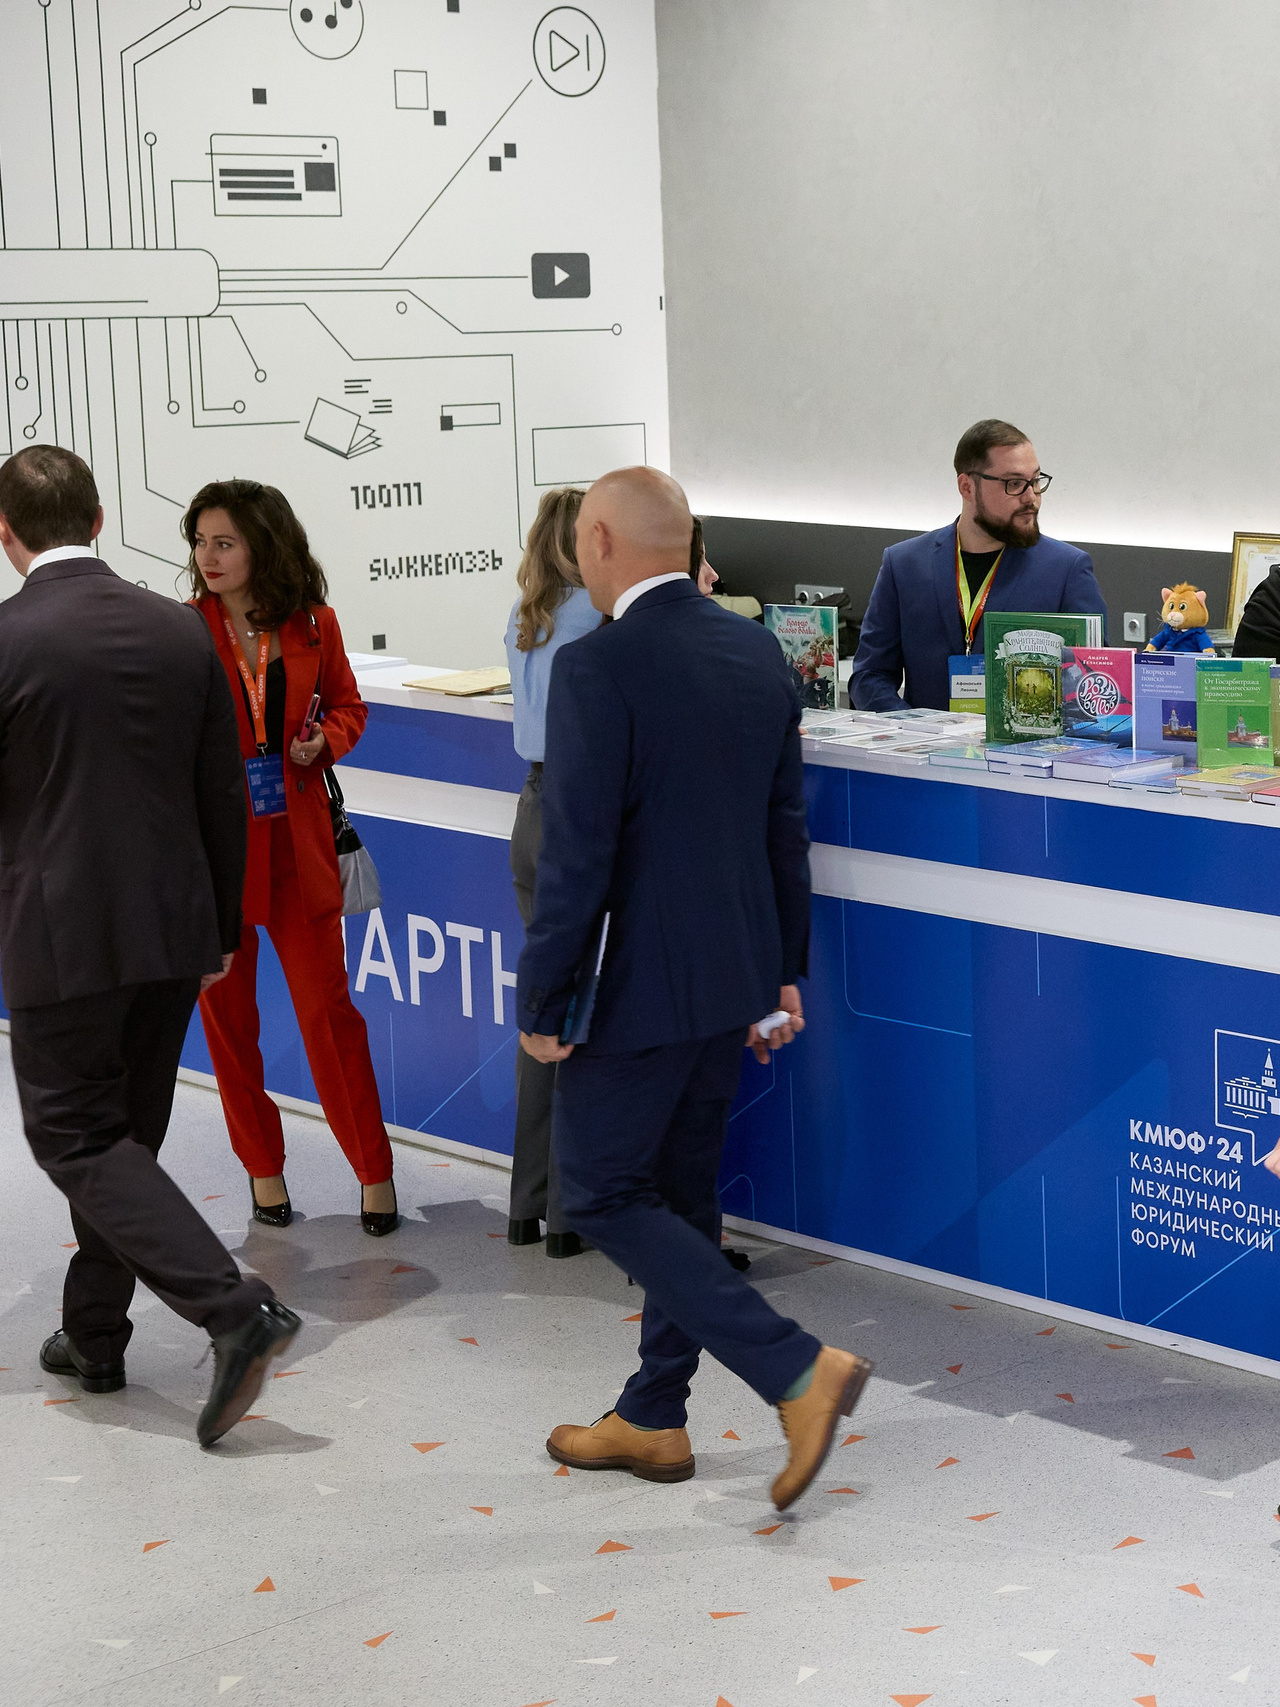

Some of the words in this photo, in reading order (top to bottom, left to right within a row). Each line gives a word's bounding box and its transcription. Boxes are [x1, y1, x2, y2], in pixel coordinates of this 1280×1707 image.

[350, 482, 422, 510] 100111
[340, 907, 518, 1025] АРТН
[1129, 1118, 1244, 1164] КМЮФ'24
[1130, 1151, 1241, 1192] КАЗАНСКИЙ
[1131, 1202, 1274, 1252] ЮРИДИЧЕСКИЙ
[1131, 1228, 1196, 1258] ФОРУМ
